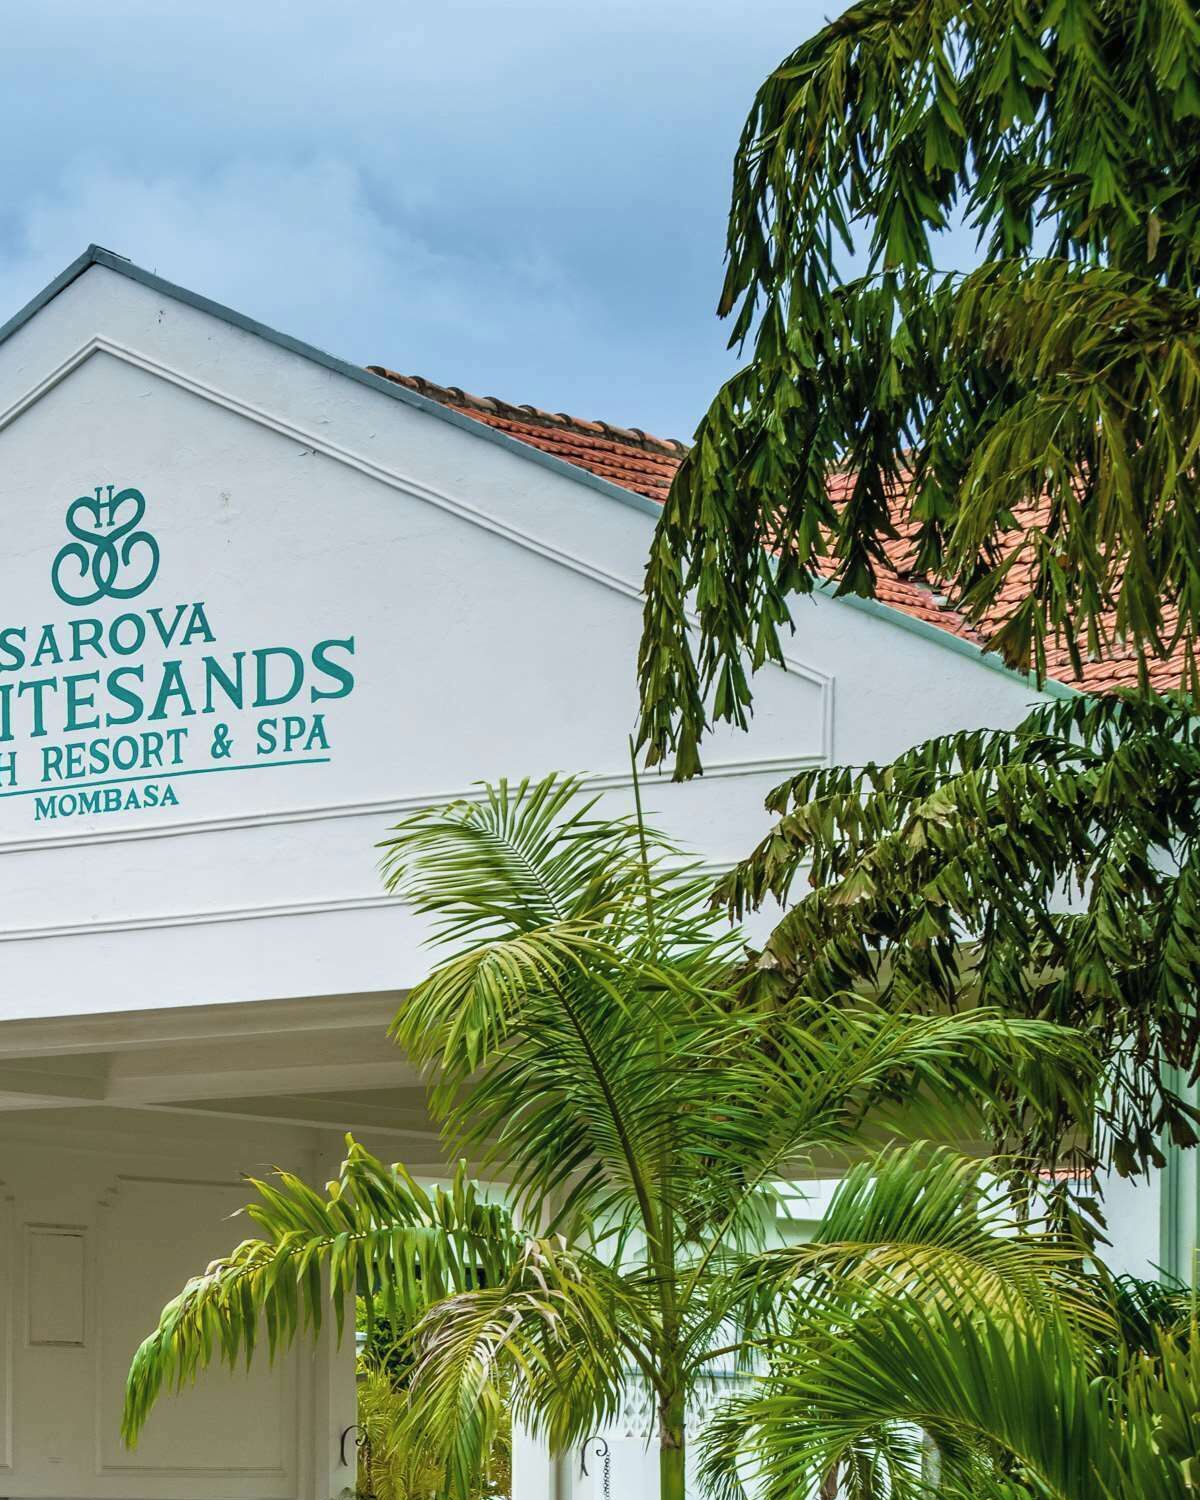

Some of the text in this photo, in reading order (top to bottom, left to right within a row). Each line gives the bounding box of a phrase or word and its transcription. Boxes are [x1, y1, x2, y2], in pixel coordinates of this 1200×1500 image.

[41, 728, 188, 782] RESORT
[210, 723, 232, 759] &
[256, 714, 330, 755] SPA
[34, 784, 179, 821] MOMBASA
